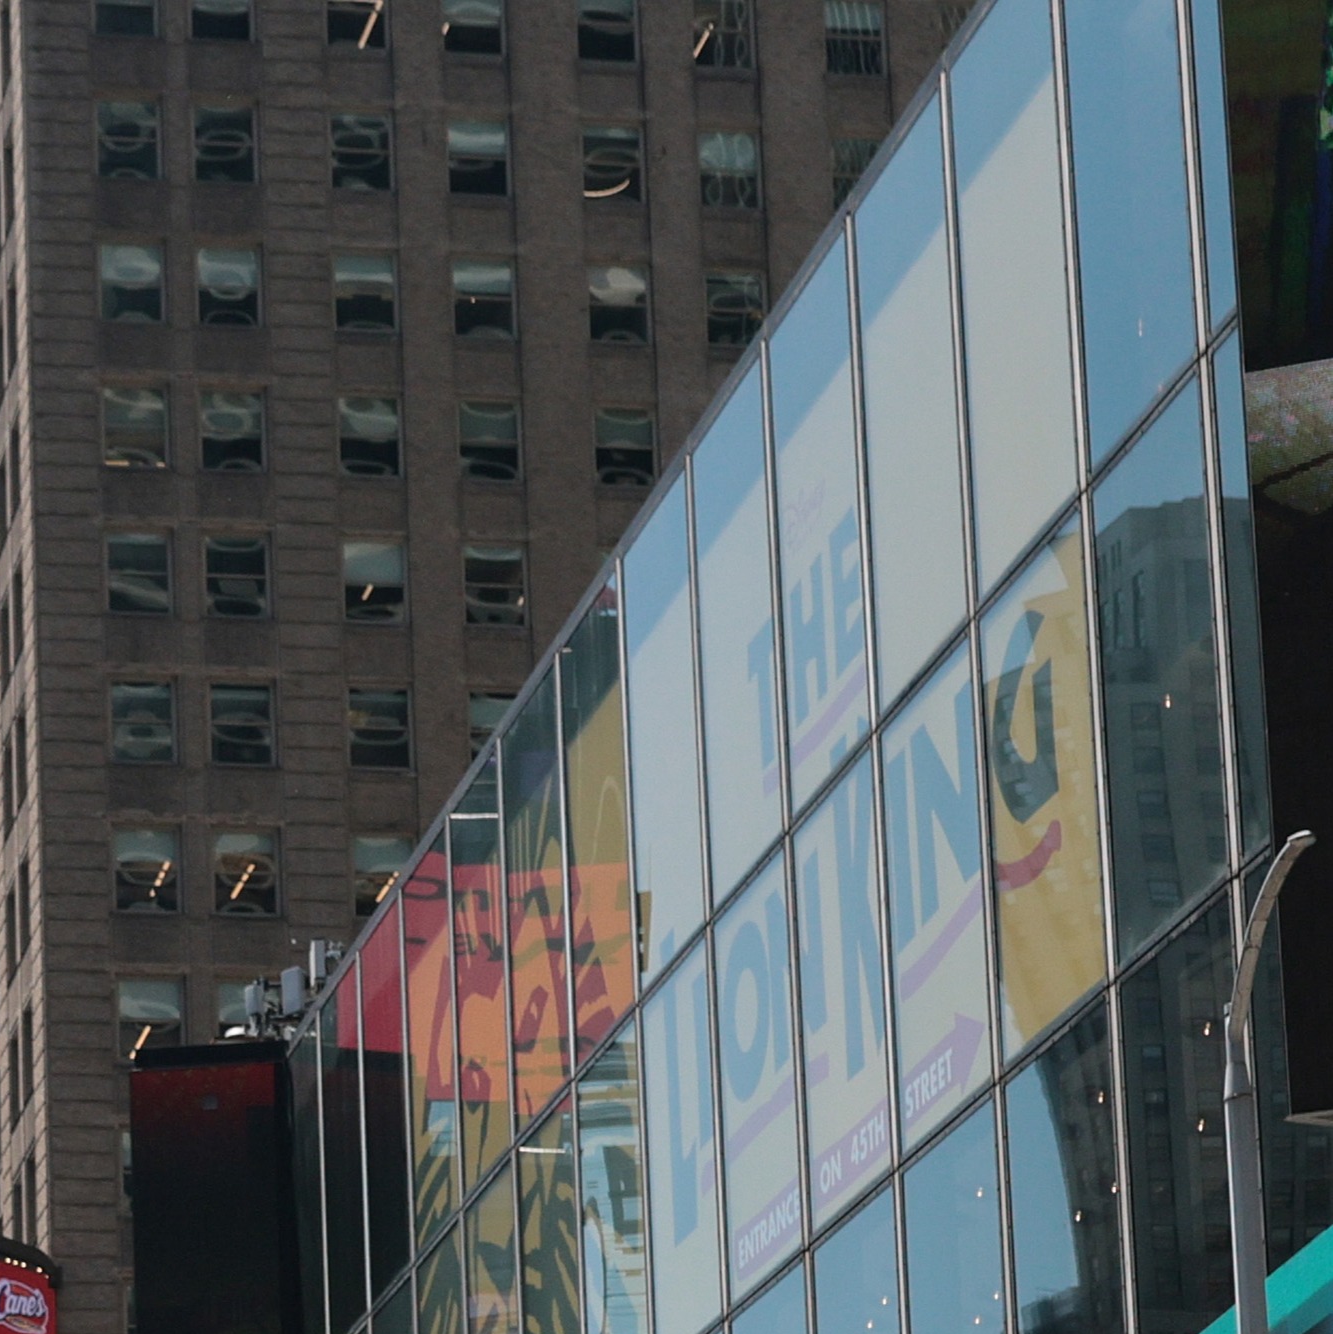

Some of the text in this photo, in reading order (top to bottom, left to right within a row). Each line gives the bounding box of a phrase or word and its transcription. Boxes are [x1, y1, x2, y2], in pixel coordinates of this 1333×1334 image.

[747, 505, 865, 770] THE
[661, 610, 1060, 1247] LION KING
[737, 1047, 954, 1270] ENTRANCE ON 45TH STREET
